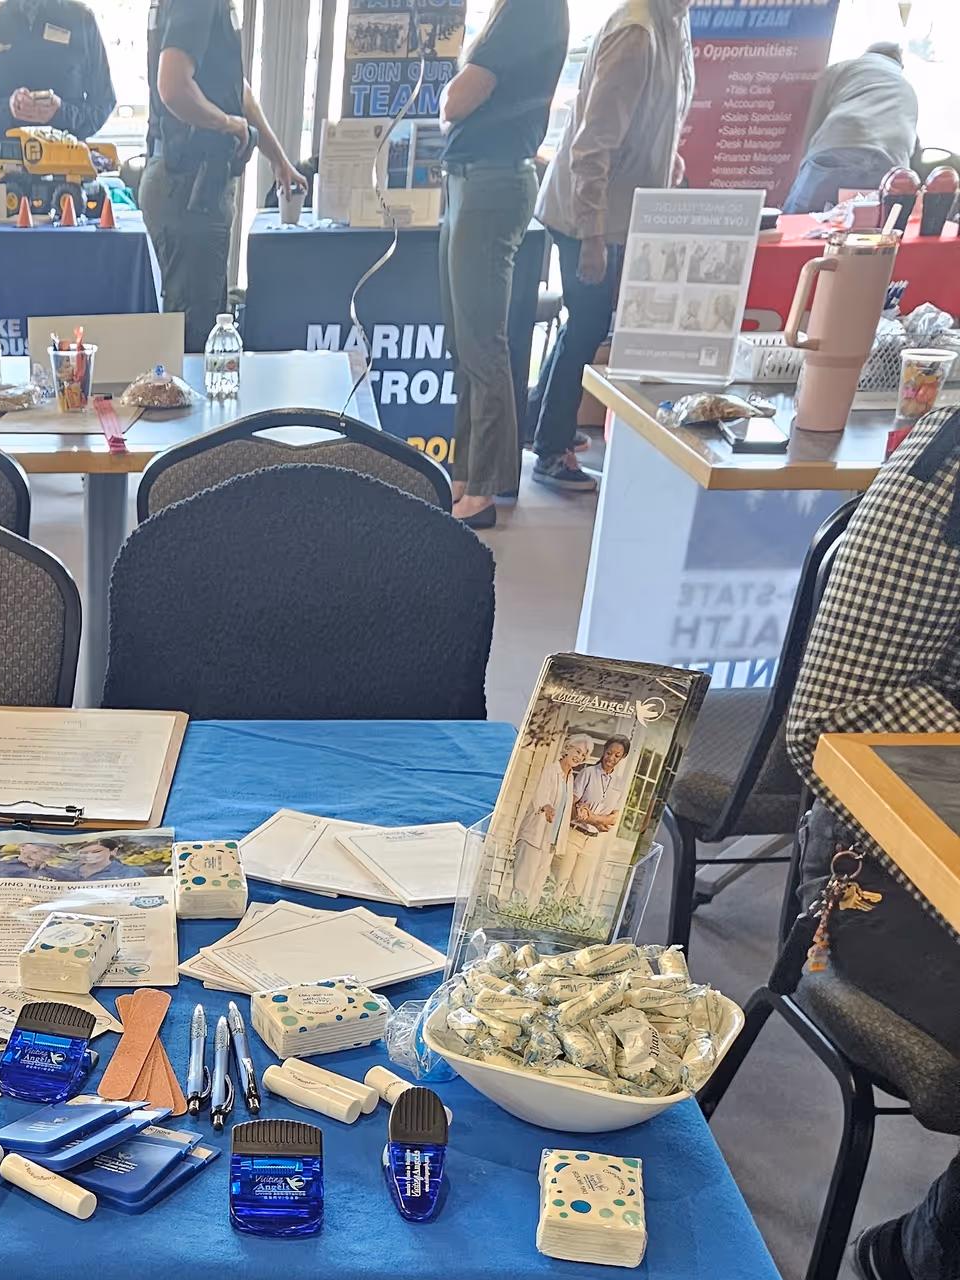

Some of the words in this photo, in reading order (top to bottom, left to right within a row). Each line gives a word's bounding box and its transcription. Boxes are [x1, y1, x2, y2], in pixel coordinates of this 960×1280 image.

[712, 10, 745, 27] OUR
[748, 9, 792, 27] TEAM
[703, 43, 799, 60] Opportunities:
[351, 61, 402, 83] JOIN
[407, 61, 453, 83] OUR
[748, 127, 786, 137] Manager
[743, 140, 782, 150] Manager
[753, 153, 791, 164] Manager
[306, 324, 452, 360] MARIN
[27, 882, 65, 890] THOSE
